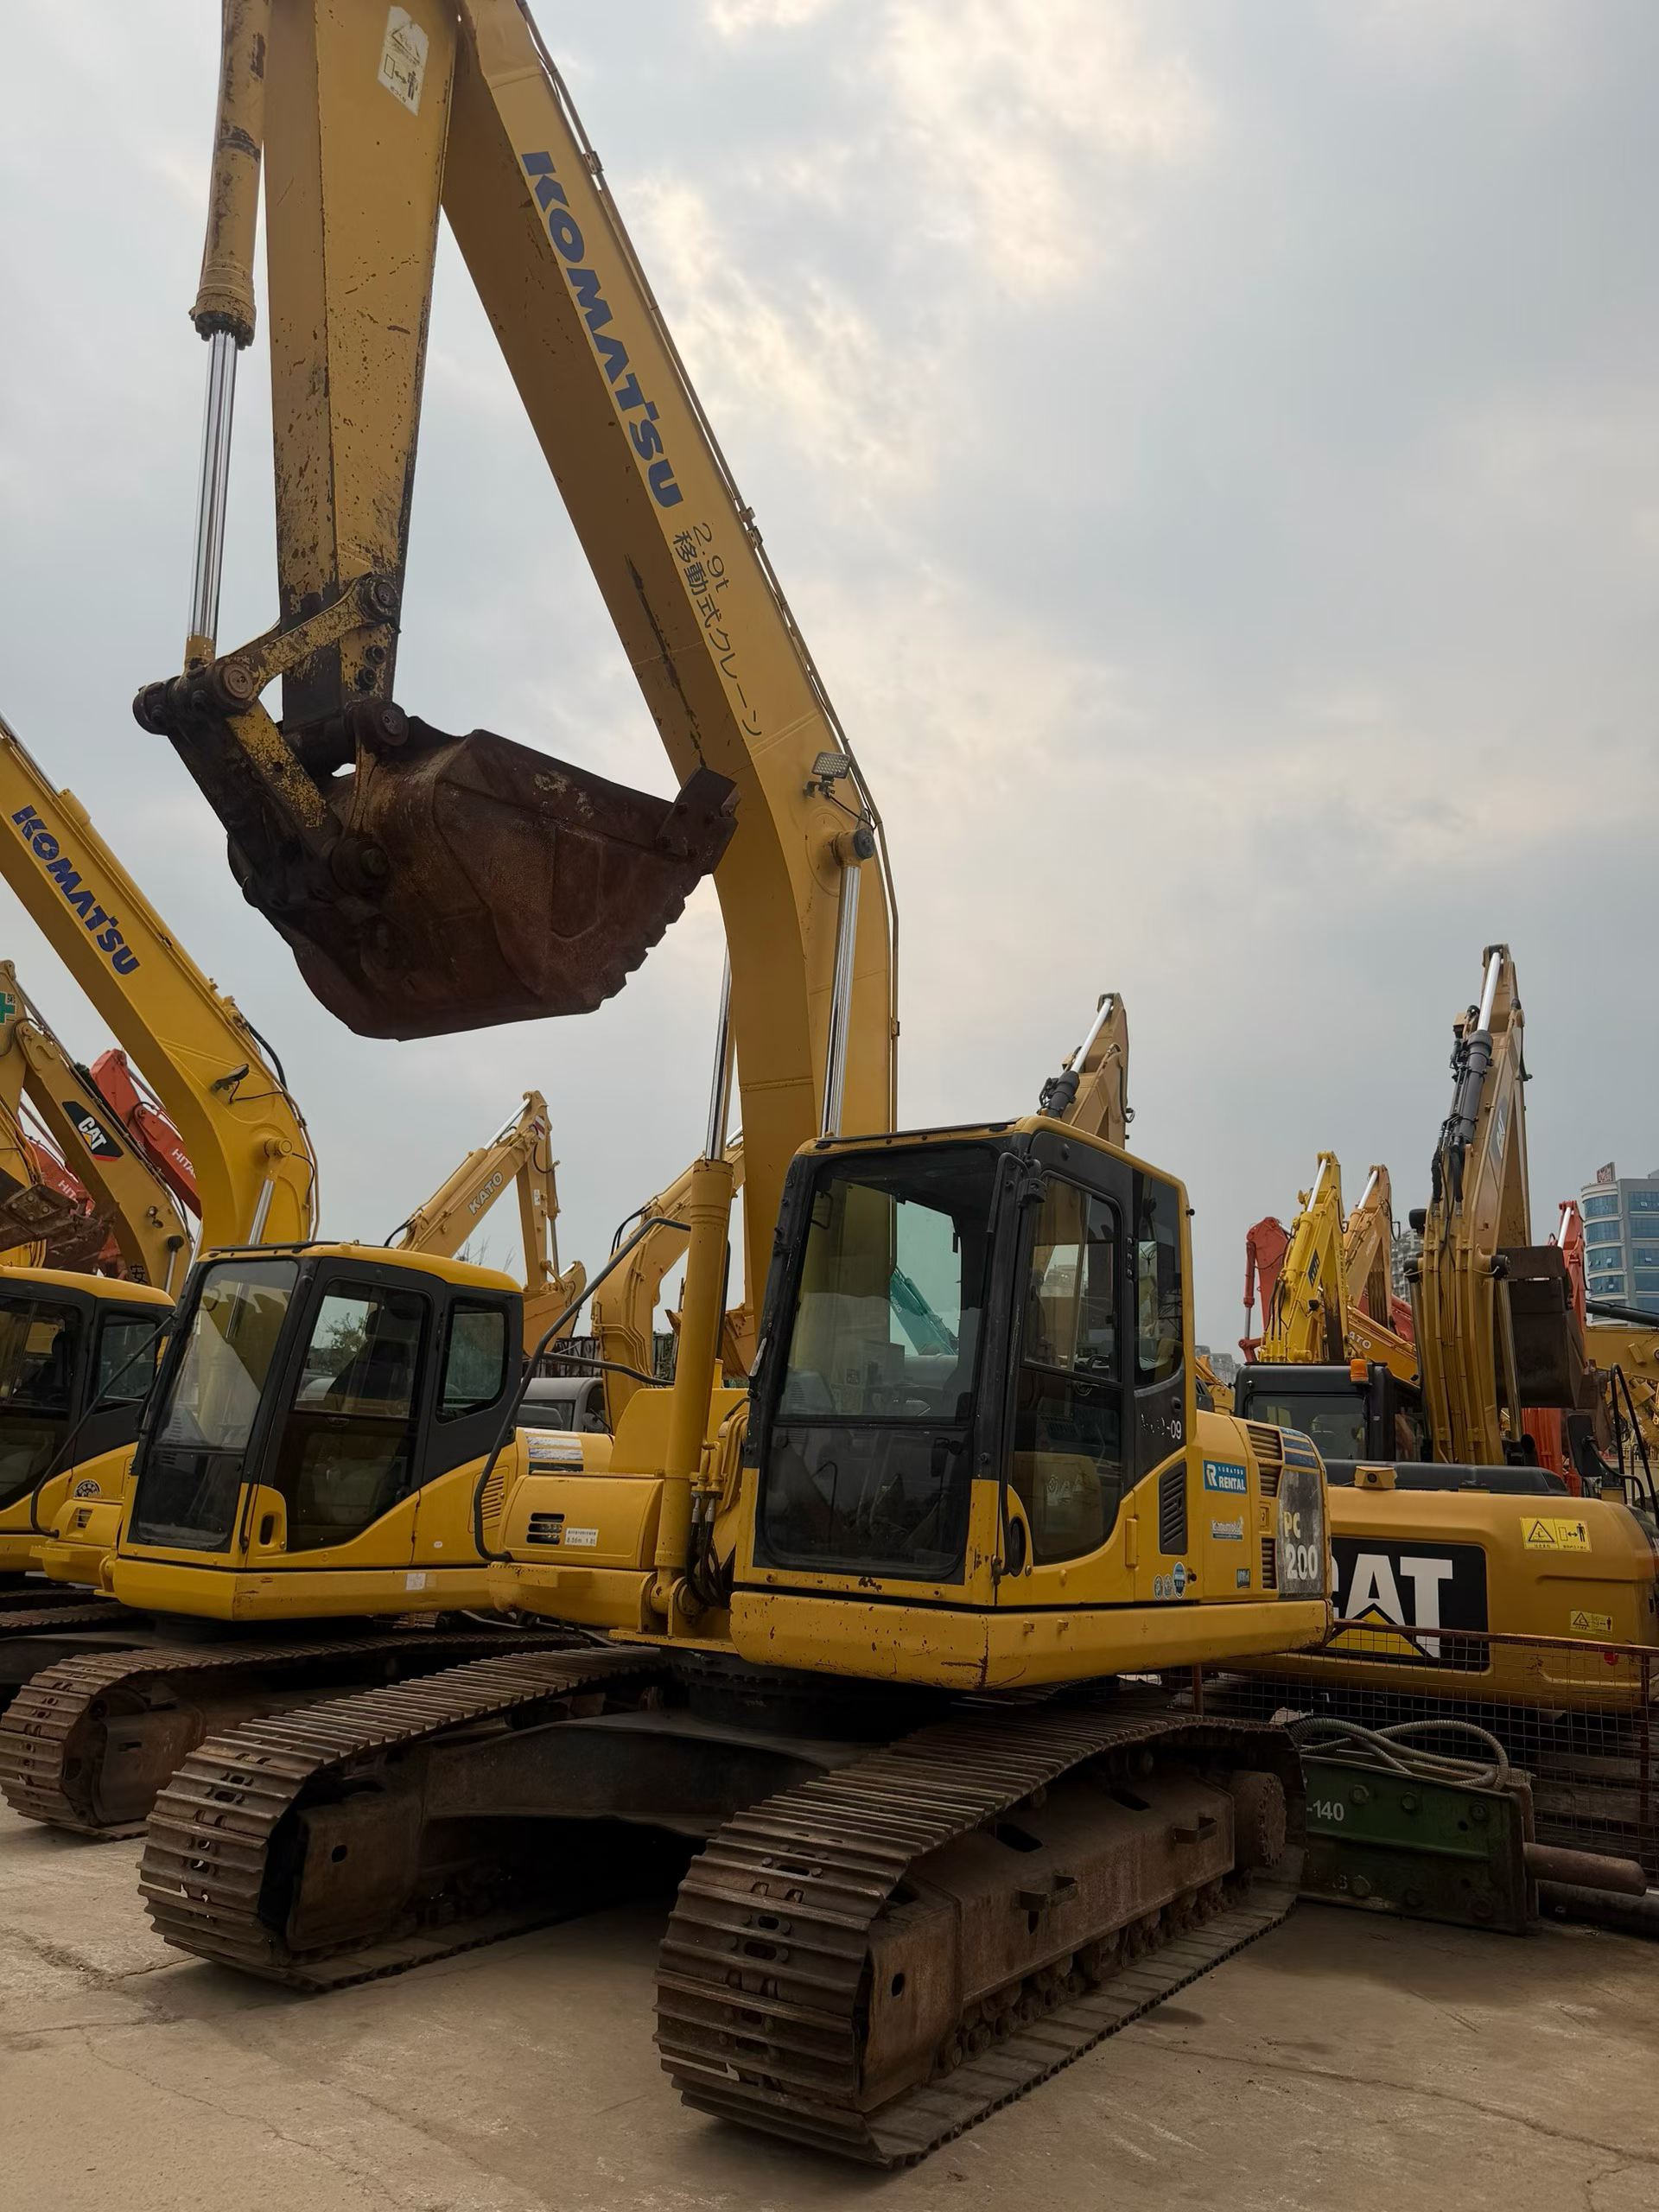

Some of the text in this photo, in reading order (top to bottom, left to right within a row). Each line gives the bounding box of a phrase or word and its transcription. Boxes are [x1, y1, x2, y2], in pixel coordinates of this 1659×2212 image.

[521, 150, 684, 509] KOMATSU
[692, 522, 730, 594] 2.9t
[672, 531, 762, 736] 移動式クレーン
[11, 804, 141, 976] KOMATSU
[78, 1116, 107, 1151] CAT
[467, 1171, 504, 1216] KATO
[1218, 1476, 1246, 1491] RENTAL
[1283, 1510, 1301, 1539] PC
[1285, 1543, 1319, 1580] 200
